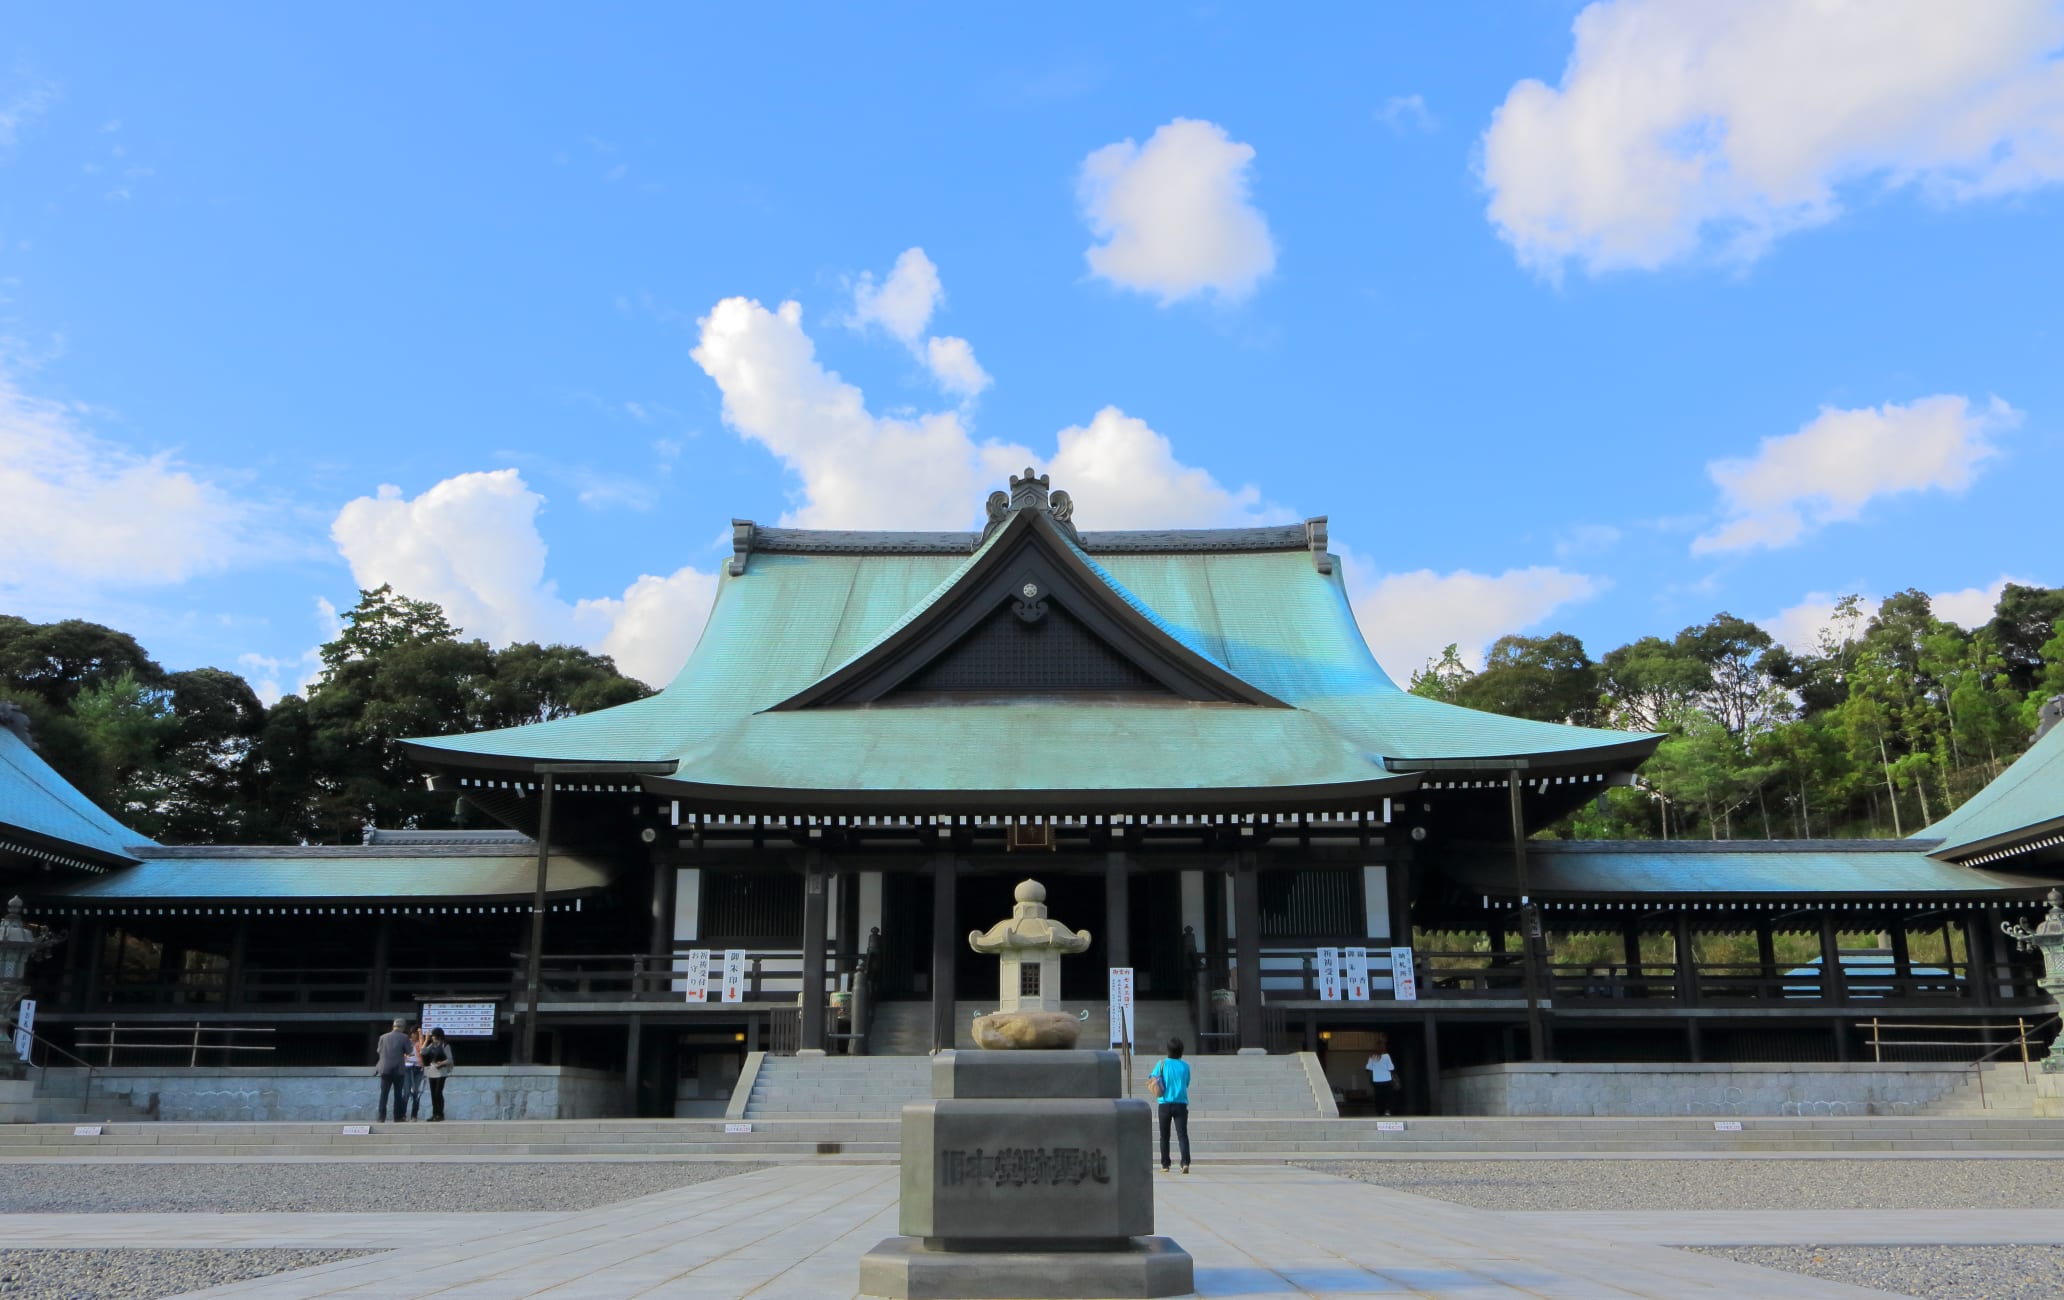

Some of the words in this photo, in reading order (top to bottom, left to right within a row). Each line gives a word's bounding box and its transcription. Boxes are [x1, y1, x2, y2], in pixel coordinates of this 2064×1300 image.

[690, 952, 698, 985] お守り
[729, 952, 739, 984] 御朱印
[1347, 950, 1357, 985] 御朱印
